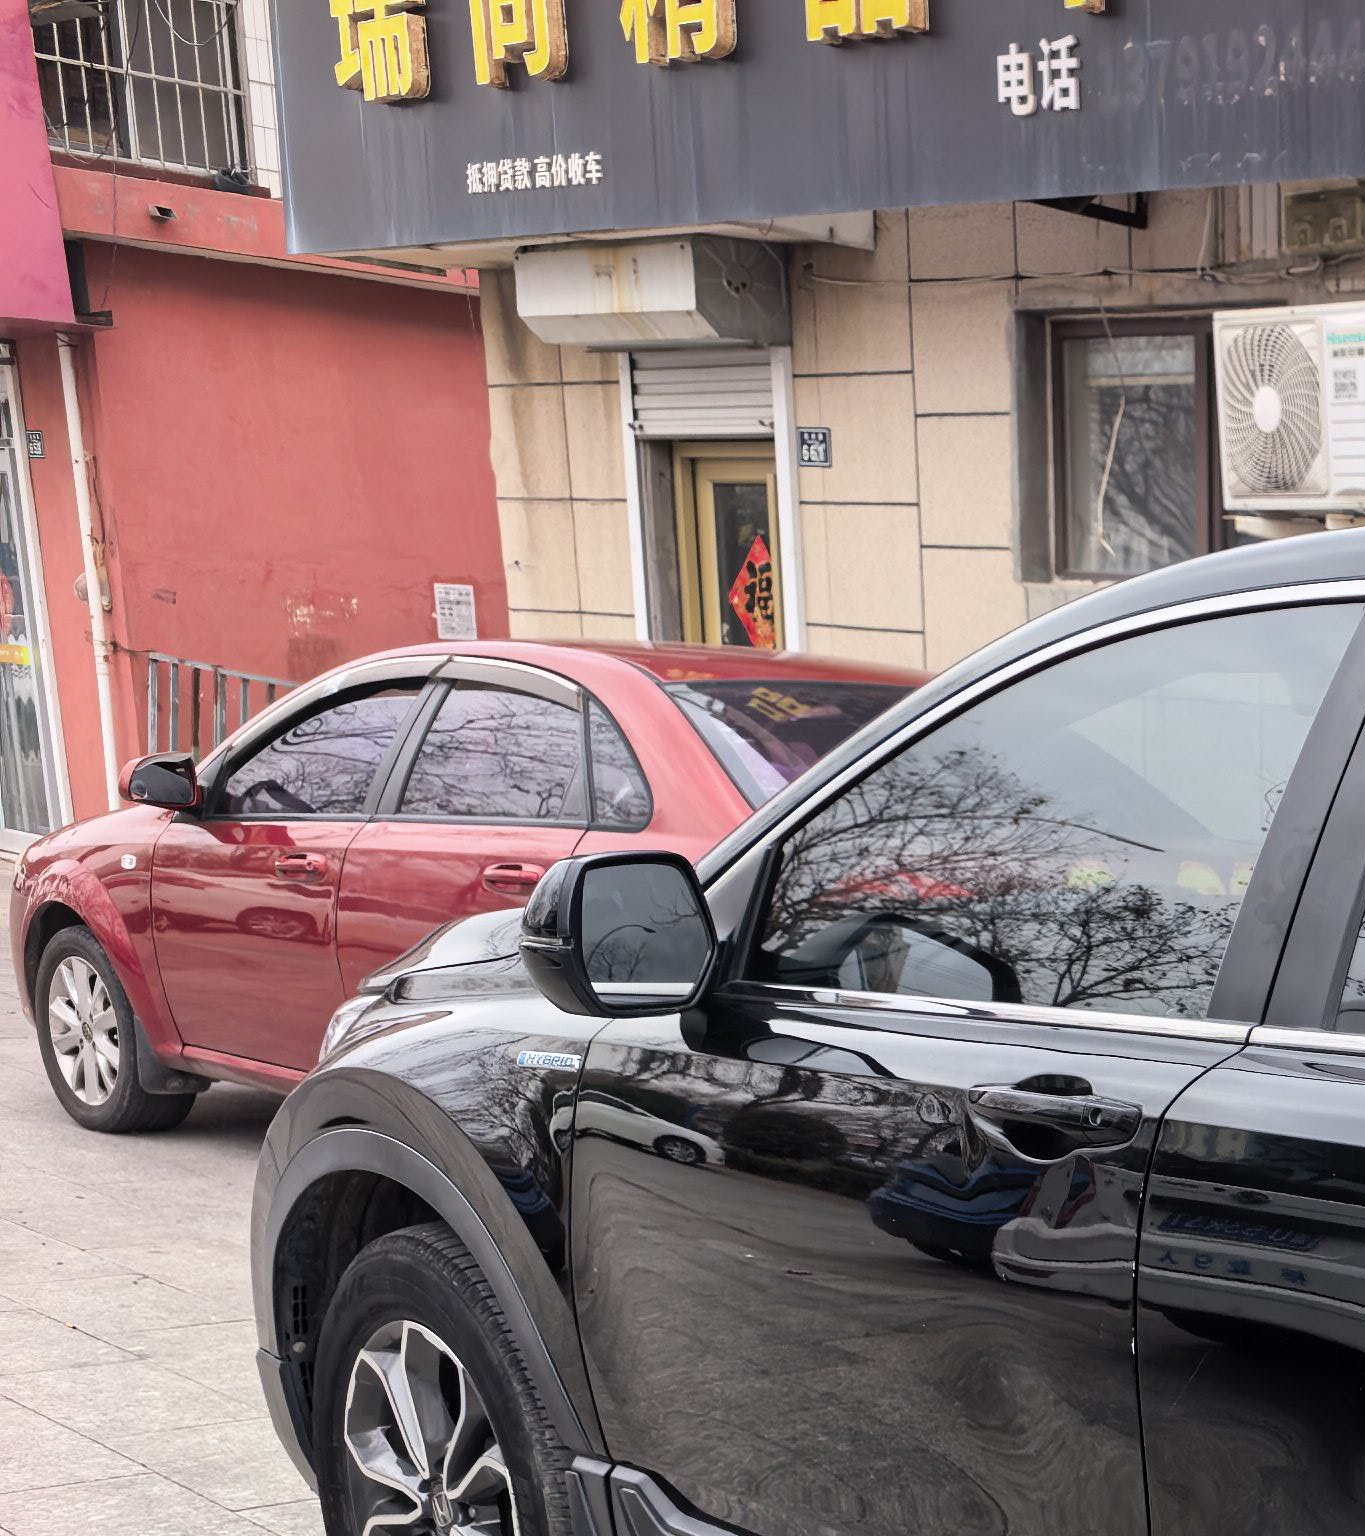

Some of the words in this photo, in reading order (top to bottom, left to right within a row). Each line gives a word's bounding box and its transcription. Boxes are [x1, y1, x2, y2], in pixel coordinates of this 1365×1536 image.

[997, 34, 1081, 115] 电话
[466, 158, 531, 194] 抵押贷款
[534, 151, 603, 188] 高价收车
[526, 1054, 574, 1067] HYBRID
